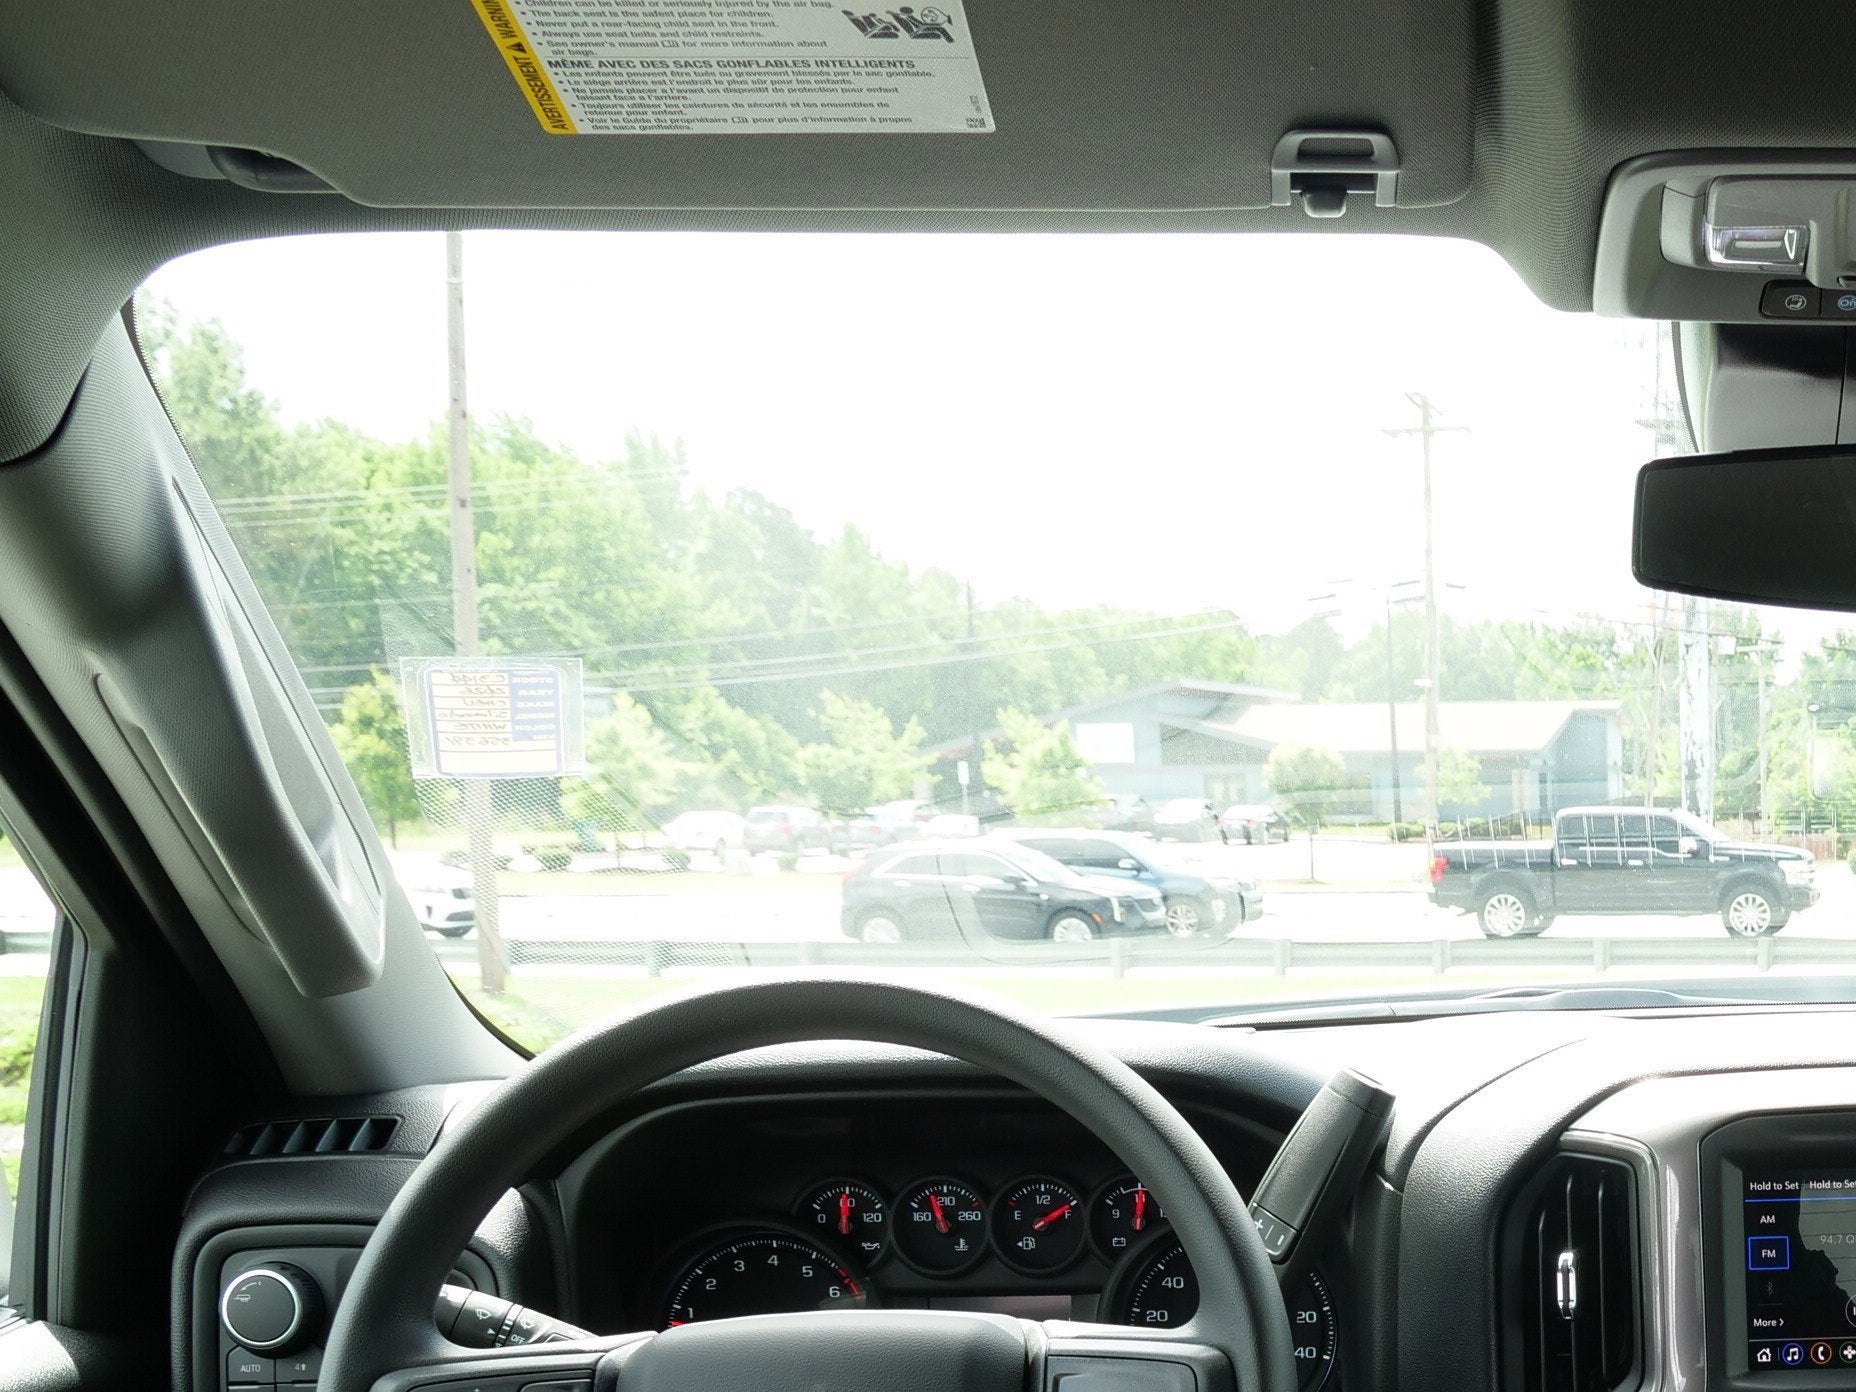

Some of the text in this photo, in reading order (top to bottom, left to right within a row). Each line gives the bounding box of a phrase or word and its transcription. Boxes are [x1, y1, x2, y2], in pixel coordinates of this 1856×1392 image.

[481, 0, 518, 39] WARNIN
[547, 59, 915, 69] MÊME AVEC DES SACS GONFLABLES INTELLIGENTS
[513, 56, 569, 130] AVERTISSEMENT
[1750, 1181, 1799, 1190] Hold to Set
[1809, 1180, 1830, 1189] Hold
[1832, 1180, 1842, 1189] to
[937, 1196, 956, 1206] 210
[1036, 1195, 1050, 1205] 1/2
[818, 1214, 826, 1223] 0
[863, 1212, 882, 1223] 120
[913, 1212, 932, 1222] 160
[958, 1211, 981, 1221] 260
[1014, 1210, 1022, 1220] E
[1064, 1210, 1072, 1220] F
[1112, 1209, 1120, 1219] 9
[1760, 1215, 1775, 1224] AM
[1820, 1235, 1842, 1244] 94.7
[1762, 1249, 1776, 1258] FM
[768, 1255, 779, 1266] 4
[734, 1260, 745, 1272] 3
[802, 1265, 813, 1278] 5
[705, 1278, 717, 1290] 2
[1161, 1277, 1184, 1289] 40
[829, 1286, 840, 1298] 6
[687, 1308, 694, 1319] 1
[1146, 1310, 1168, 1322] 20
[1753, 1318, 1777, 1327] More
[511, 1334, 526, 1344] OFF
[240, 1364, 261, 1373] AUTO
